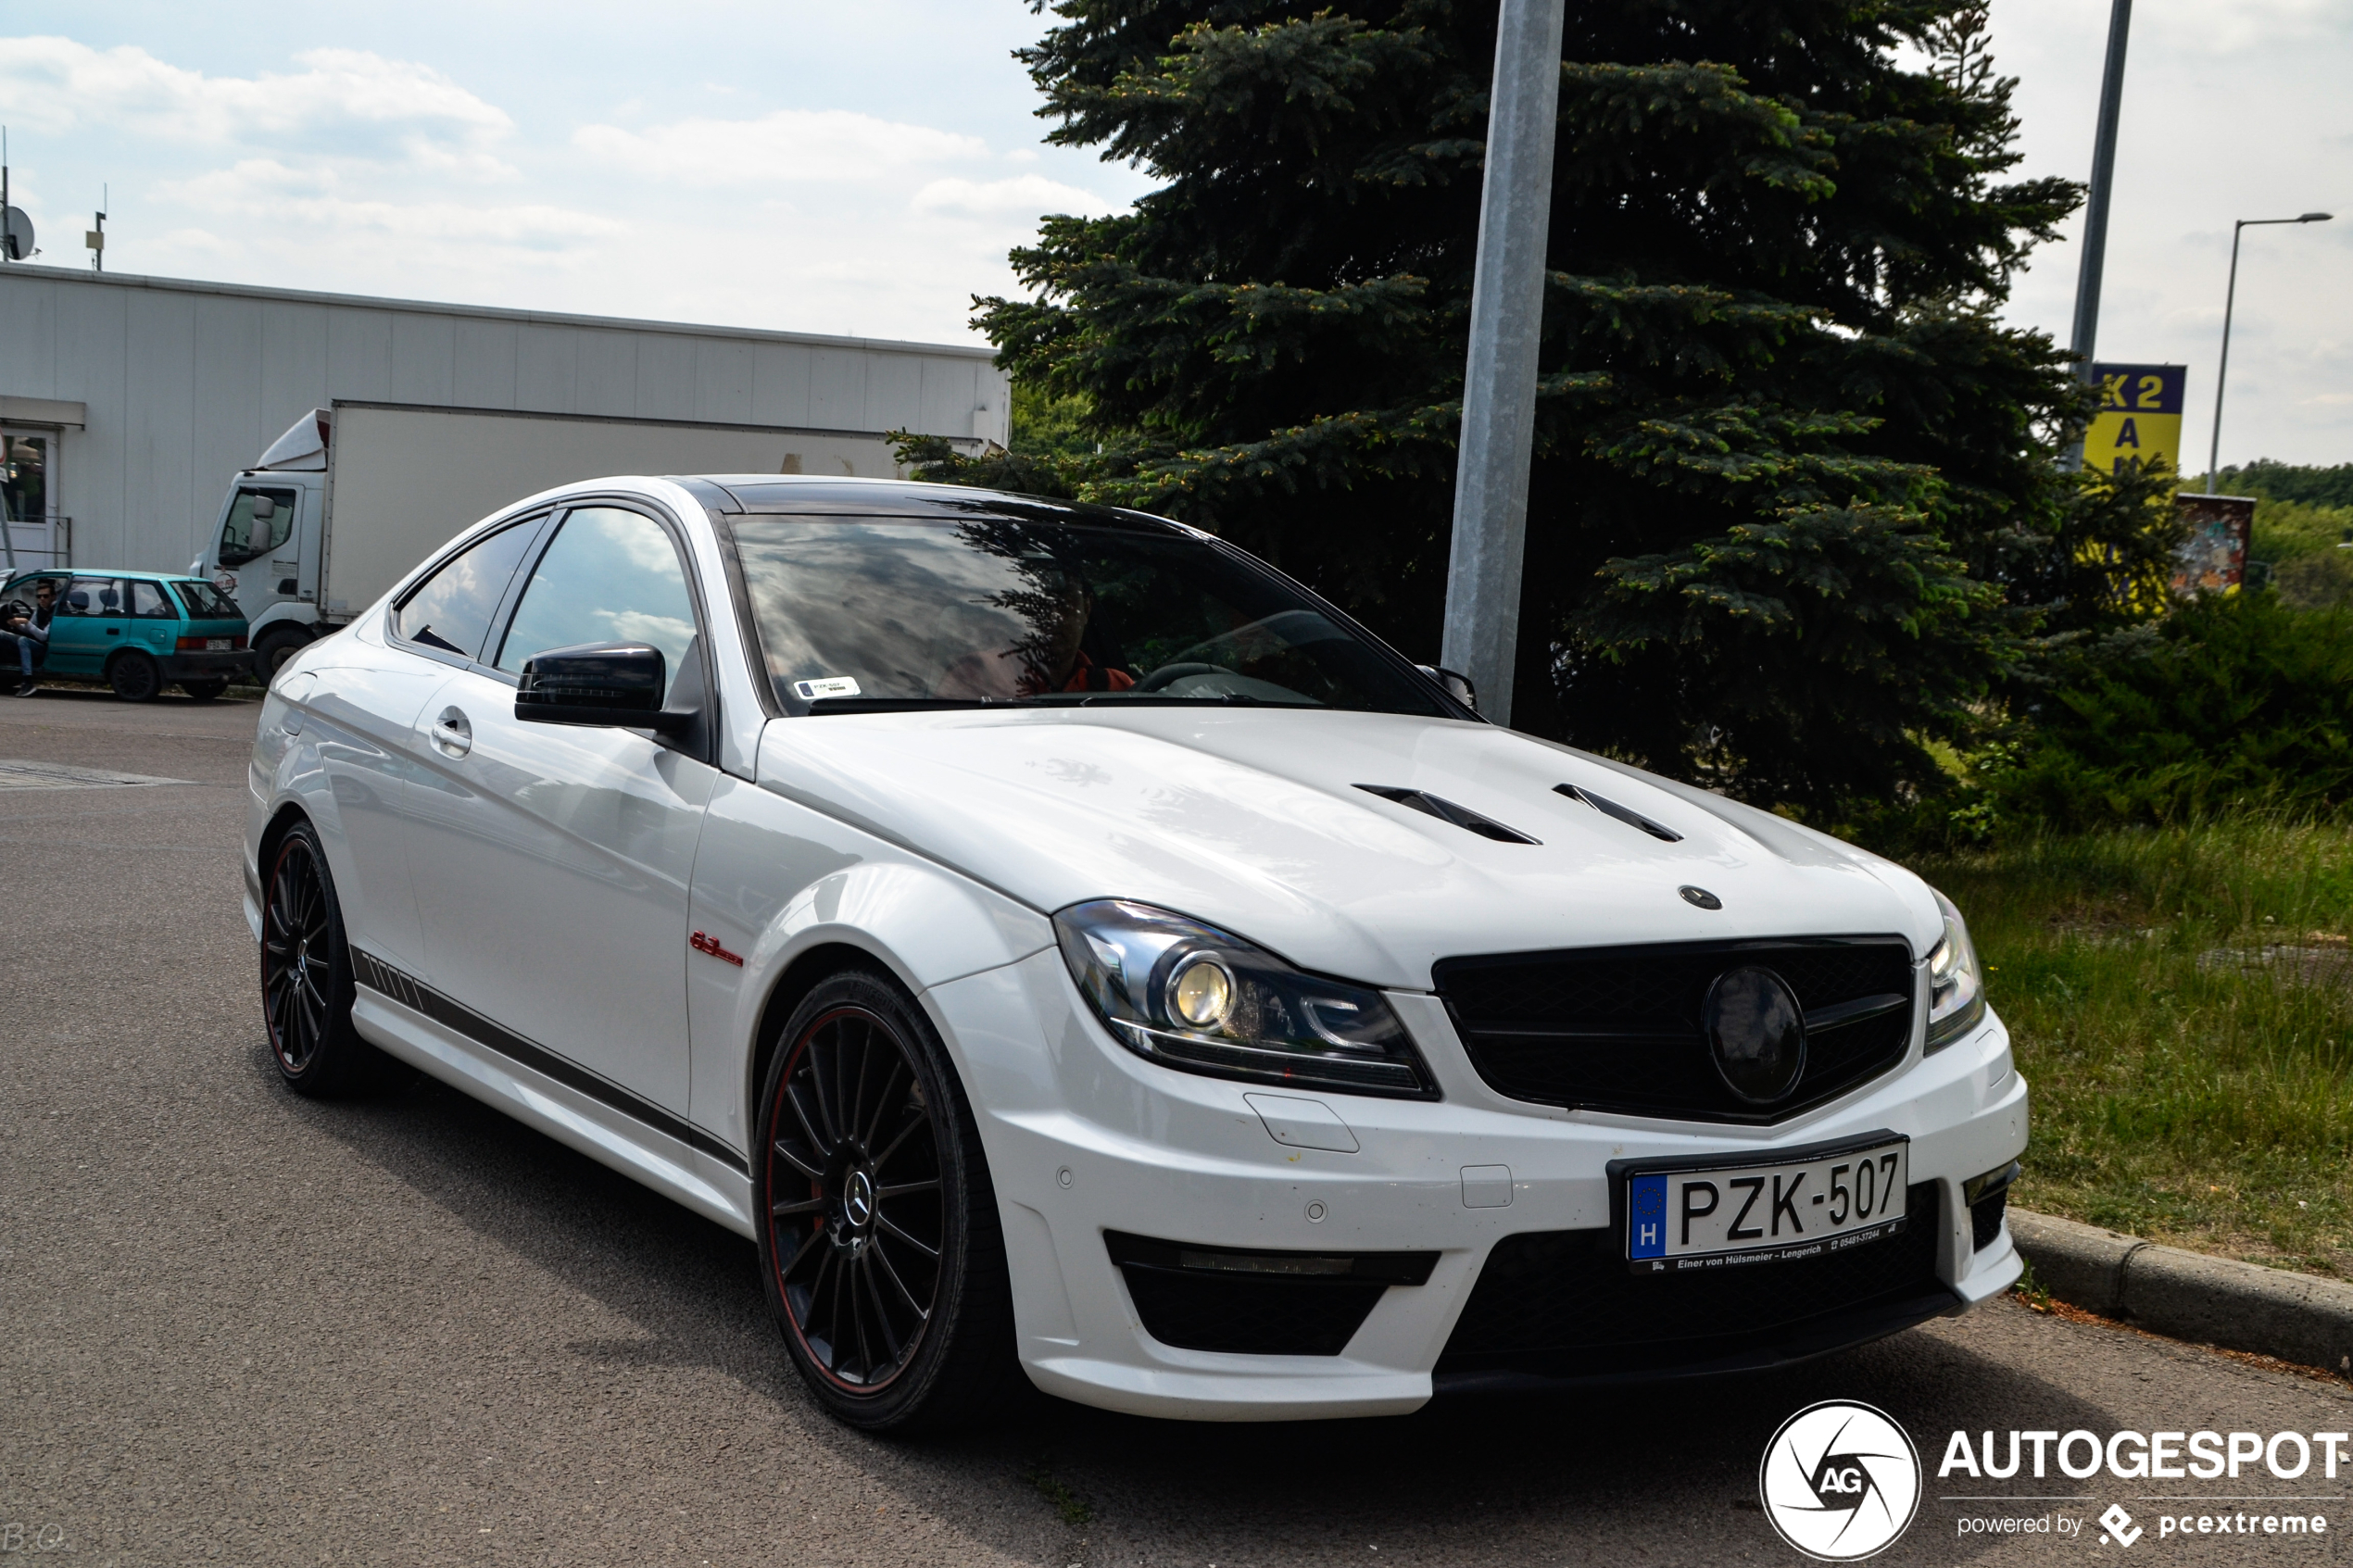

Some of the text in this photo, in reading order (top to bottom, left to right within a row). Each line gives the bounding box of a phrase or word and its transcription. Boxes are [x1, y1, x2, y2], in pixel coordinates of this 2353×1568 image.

[2101, 373, 2164, 409] K2
[1680, 1151, 1899, 1246] PZK-507
[1640, 1223, 1657, 1246] H
[1840, 1230, 1880, 1248] 05481-37244
[1678, 1259, 1703, 1269] Einer
[1705, 1258, 1723, 1266] von
[1725, 1252, 1773, 1264] Hülsmeier
[1781, 1245, 1821, 1260] Lengerich
